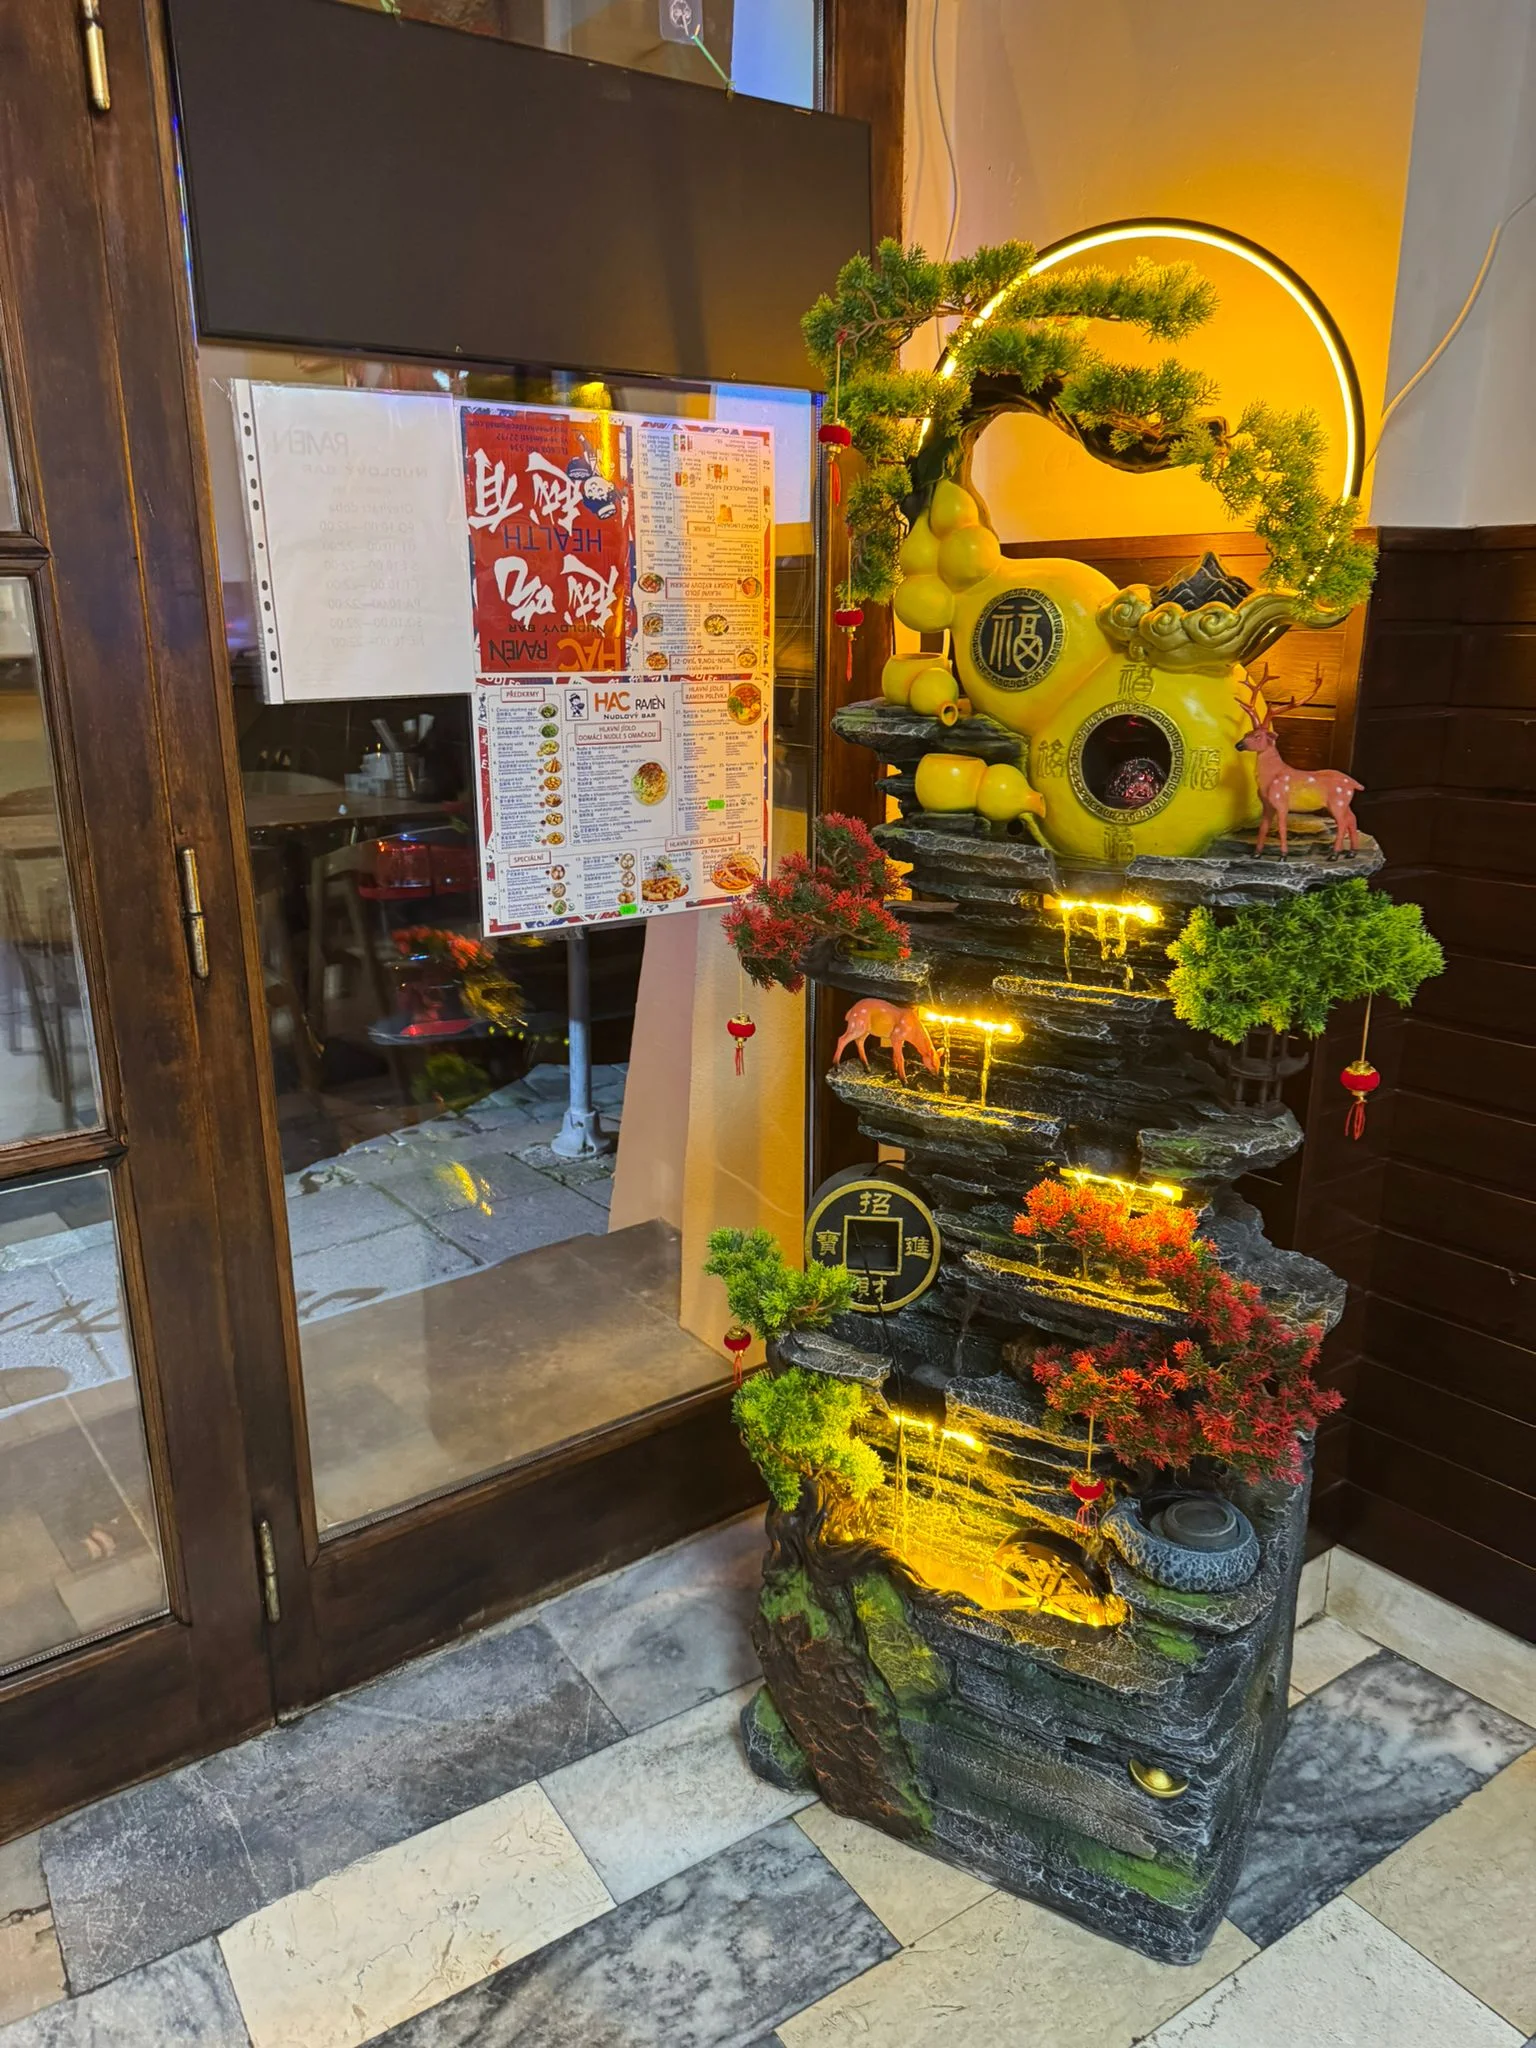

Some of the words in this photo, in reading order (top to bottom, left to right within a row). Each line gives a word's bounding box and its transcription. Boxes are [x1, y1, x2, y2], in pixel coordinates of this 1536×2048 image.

[503, 526, 602, 552] HEALTH
[989, 604, 1044, 674] 福
[489, 640, 547, 668] RAMEN
[557, 638, 621, 672] HAC
[594, 691, 631, 712] HAC
[635, 694, 666, 710] RAMEN
[603, 712, 639, 720] NUDLOVÝ
[859, 1191, 892, 1215] 招
